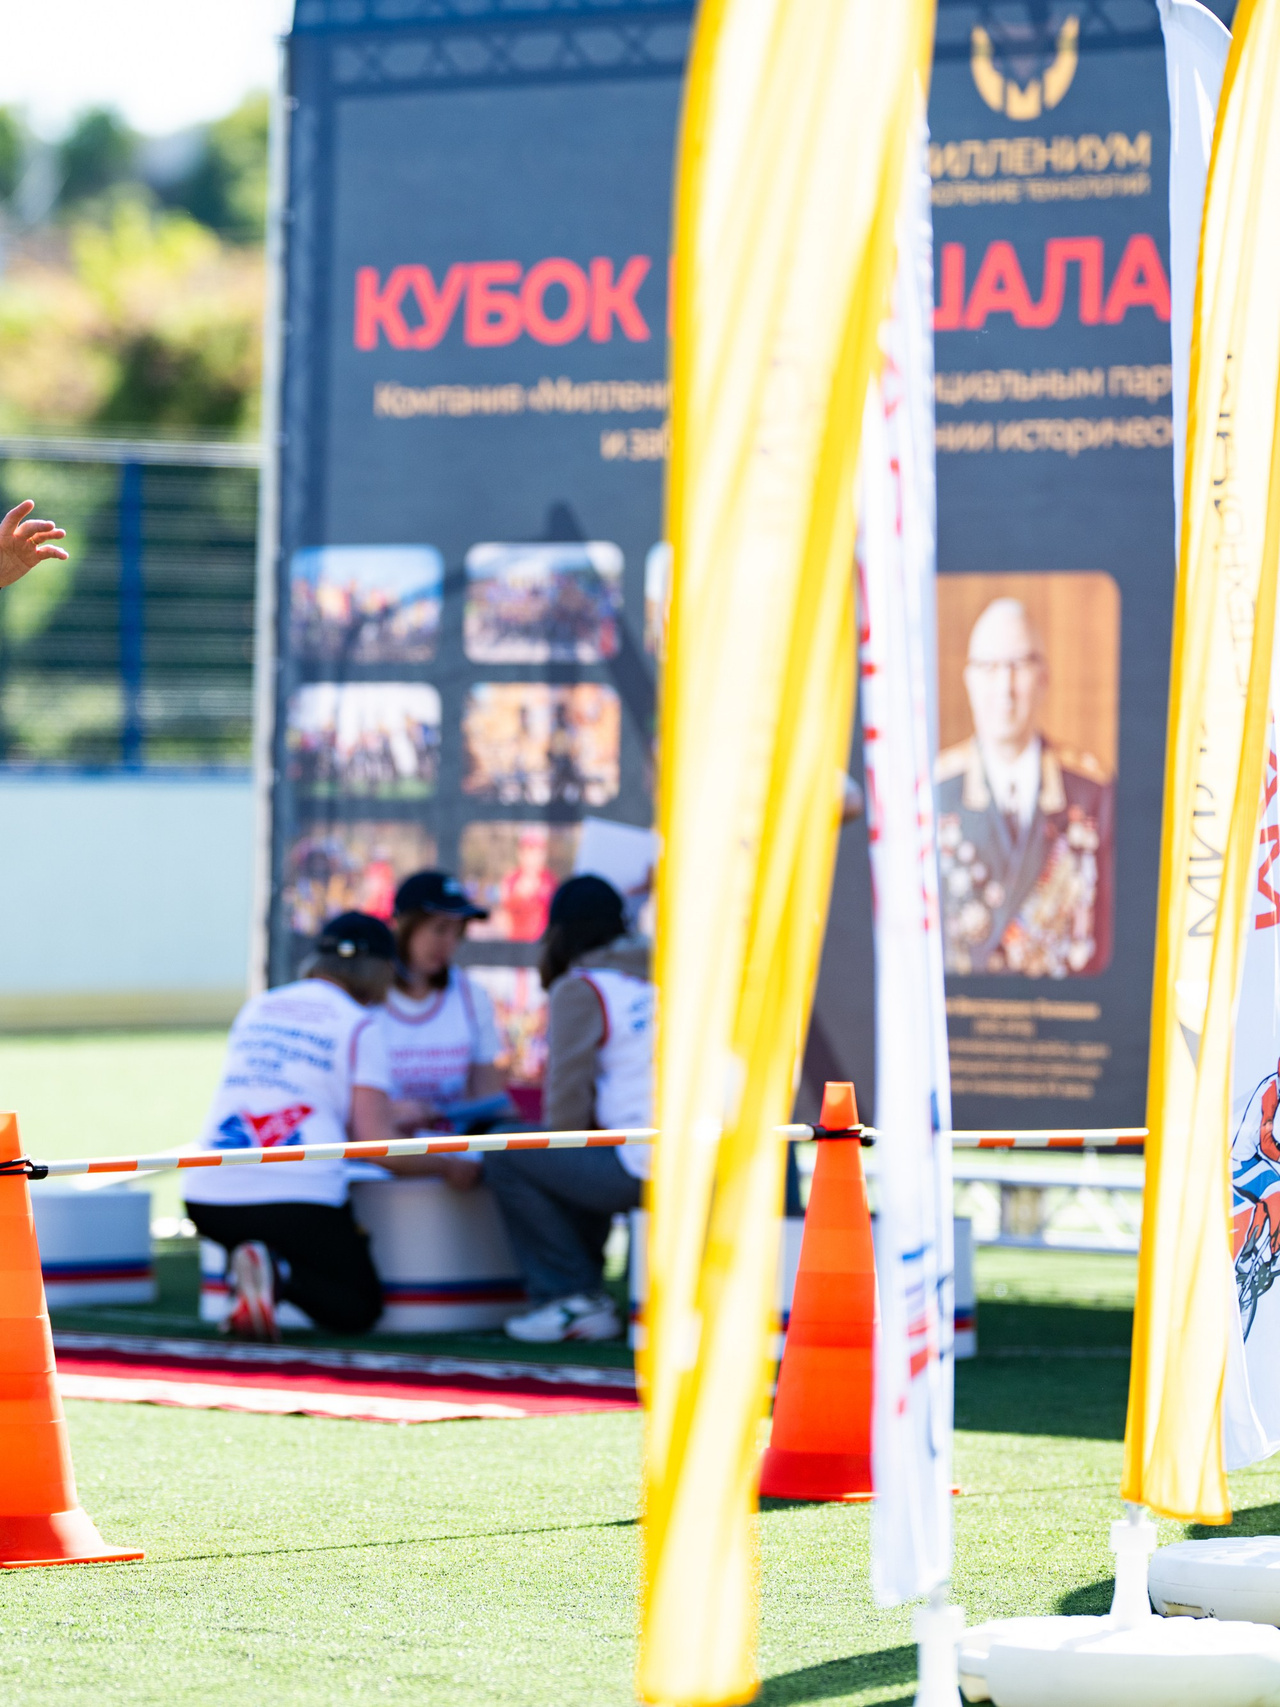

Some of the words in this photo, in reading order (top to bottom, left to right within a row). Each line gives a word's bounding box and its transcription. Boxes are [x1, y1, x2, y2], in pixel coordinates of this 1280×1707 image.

[928, 132, 1151, 178] ИЛЛЕНИУМ
[355, 254, 651, 351] КУБОК
[1108, 364, 1171, 404] пар
[997, 415, 1172, 458] историчес
